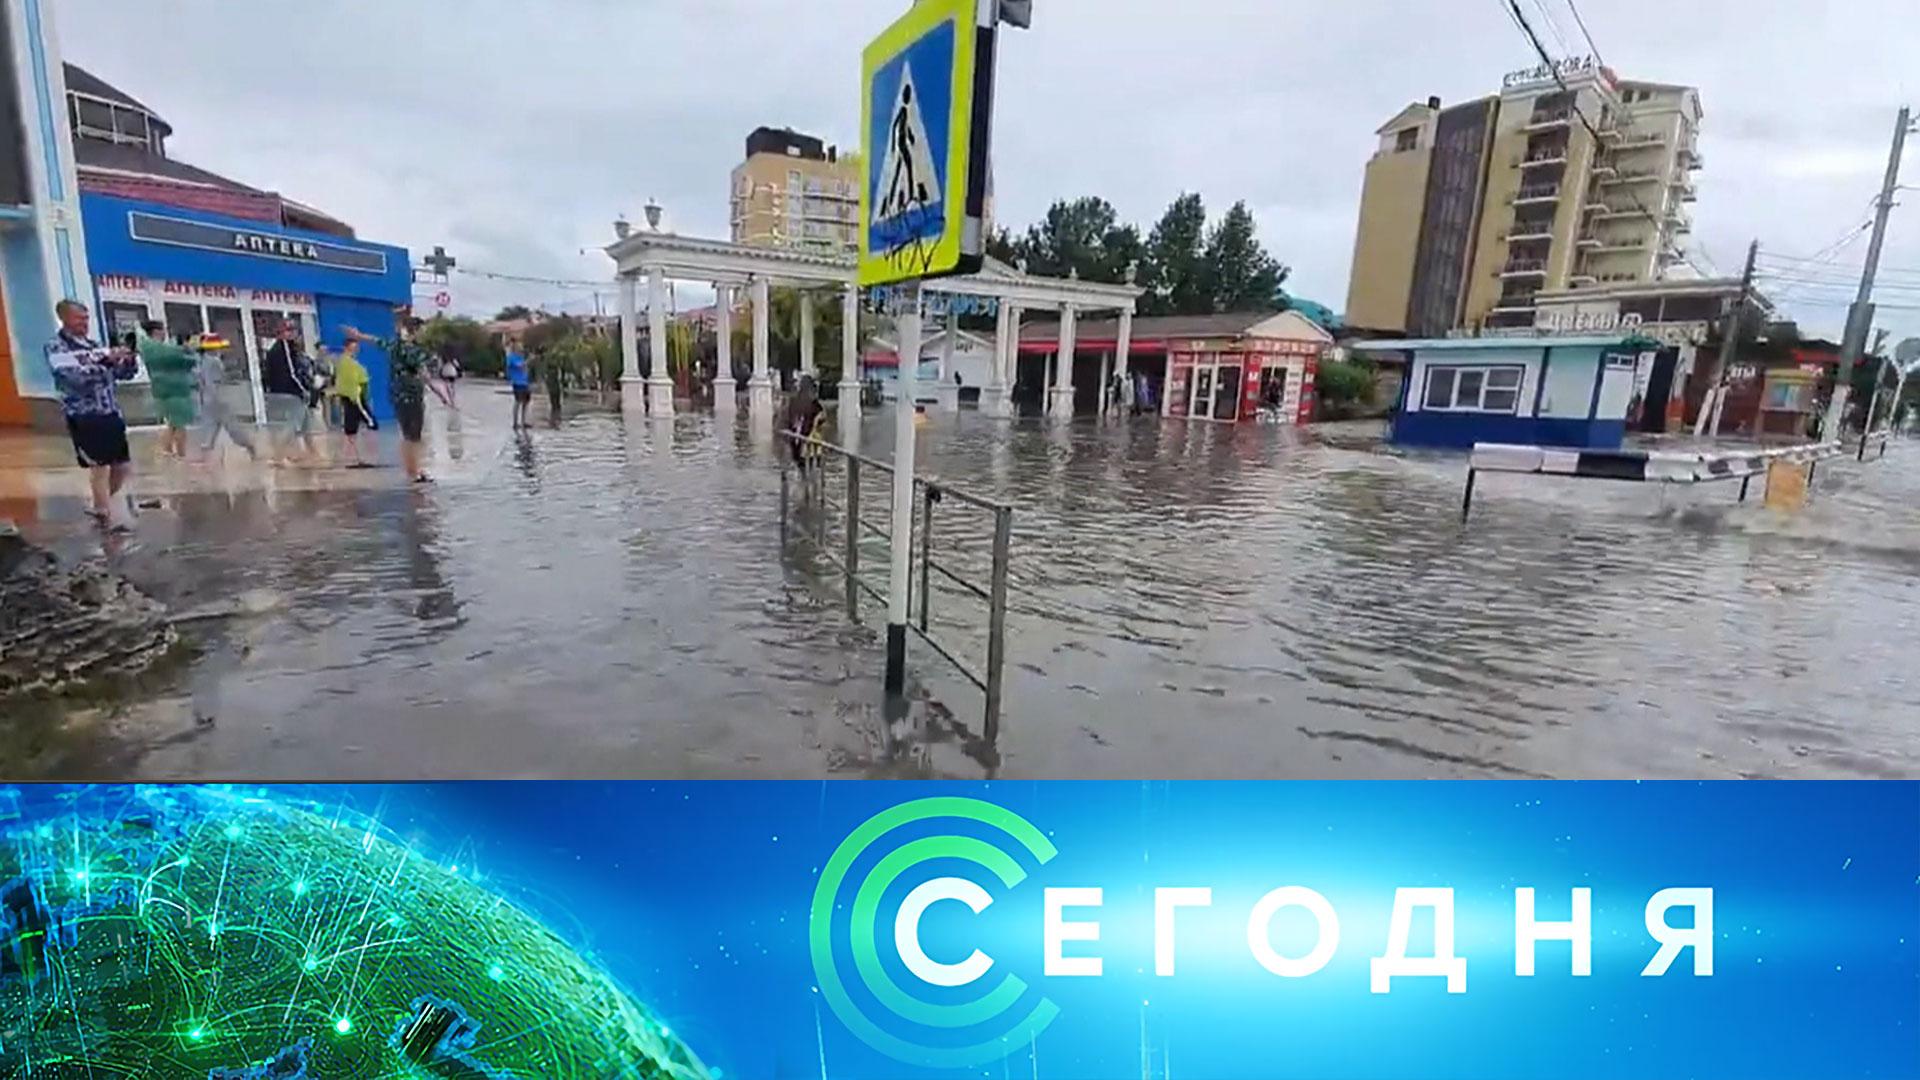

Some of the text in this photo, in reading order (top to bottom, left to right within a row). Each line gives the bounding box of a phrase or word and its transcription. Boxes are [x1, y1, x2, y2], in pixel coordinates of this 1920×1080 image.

[234, 233, 318, 258] АПТЕКА
[163, 280, 237, 299] АПТЕКА
[251, 285, 314, 306] АПТЕКА
